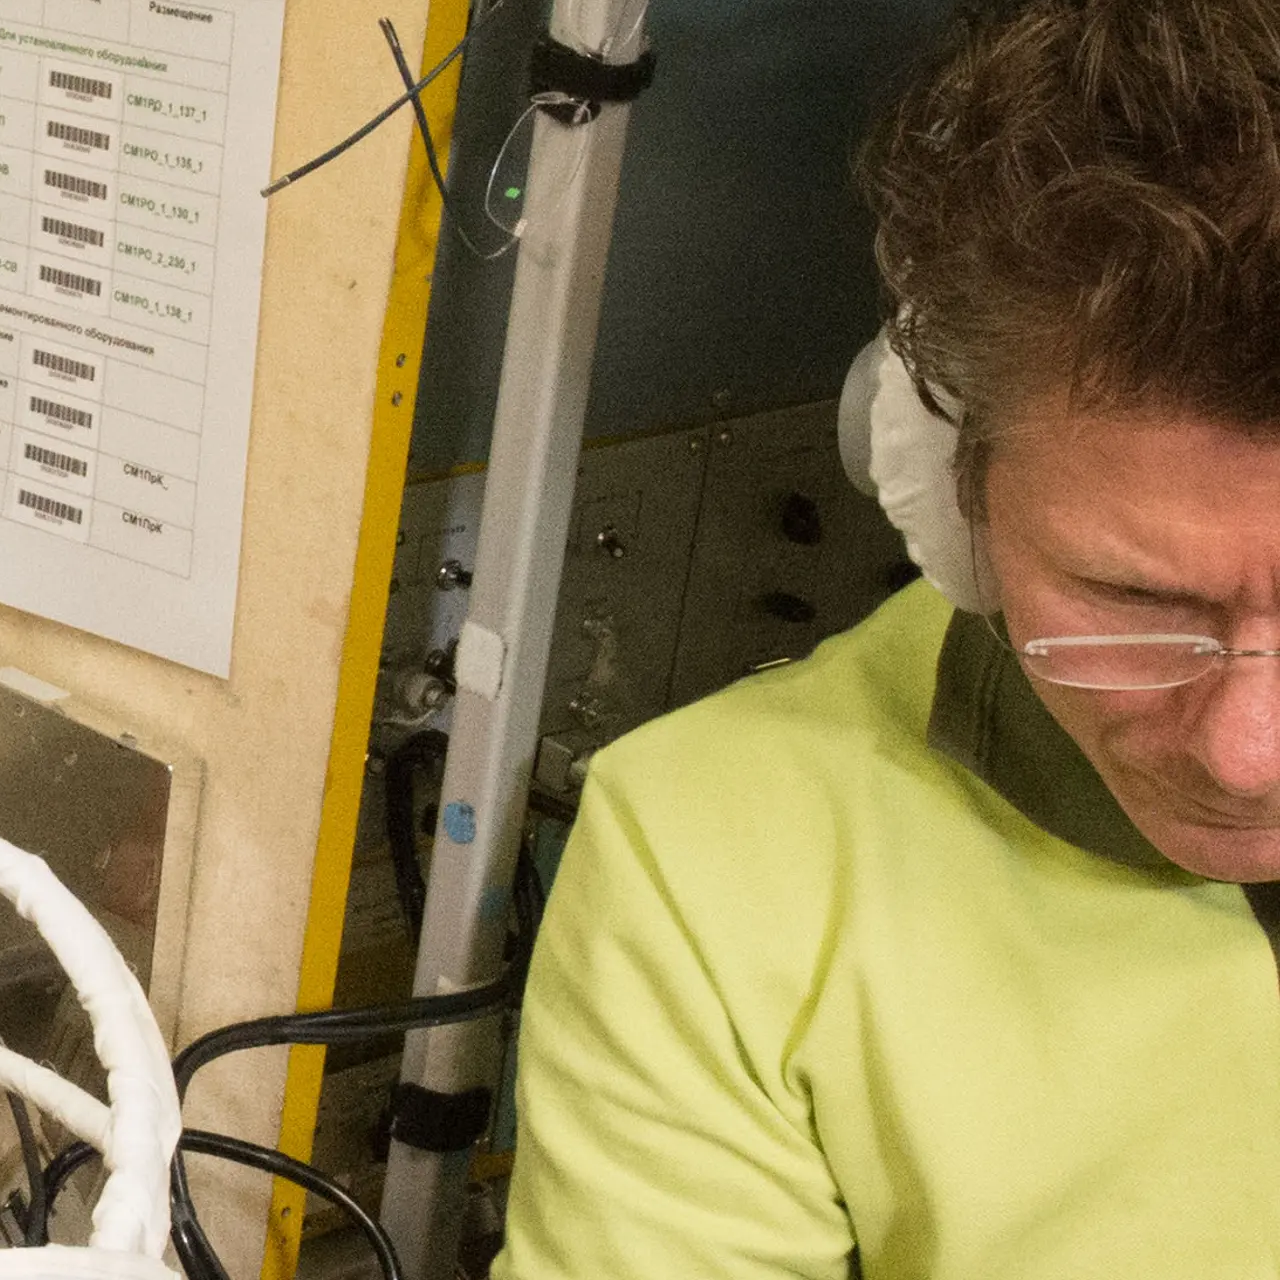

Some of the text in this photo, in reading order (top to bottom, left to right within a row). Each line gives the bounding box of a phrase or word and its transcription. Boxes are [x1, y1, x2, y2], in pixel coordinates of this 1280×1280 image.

[149, 1, 213, 23] Размещение
[17, 33, 94, 59] установленного
[96, 48, 168, 72] оборудования
[84, 326, 155, 356] оборудования
